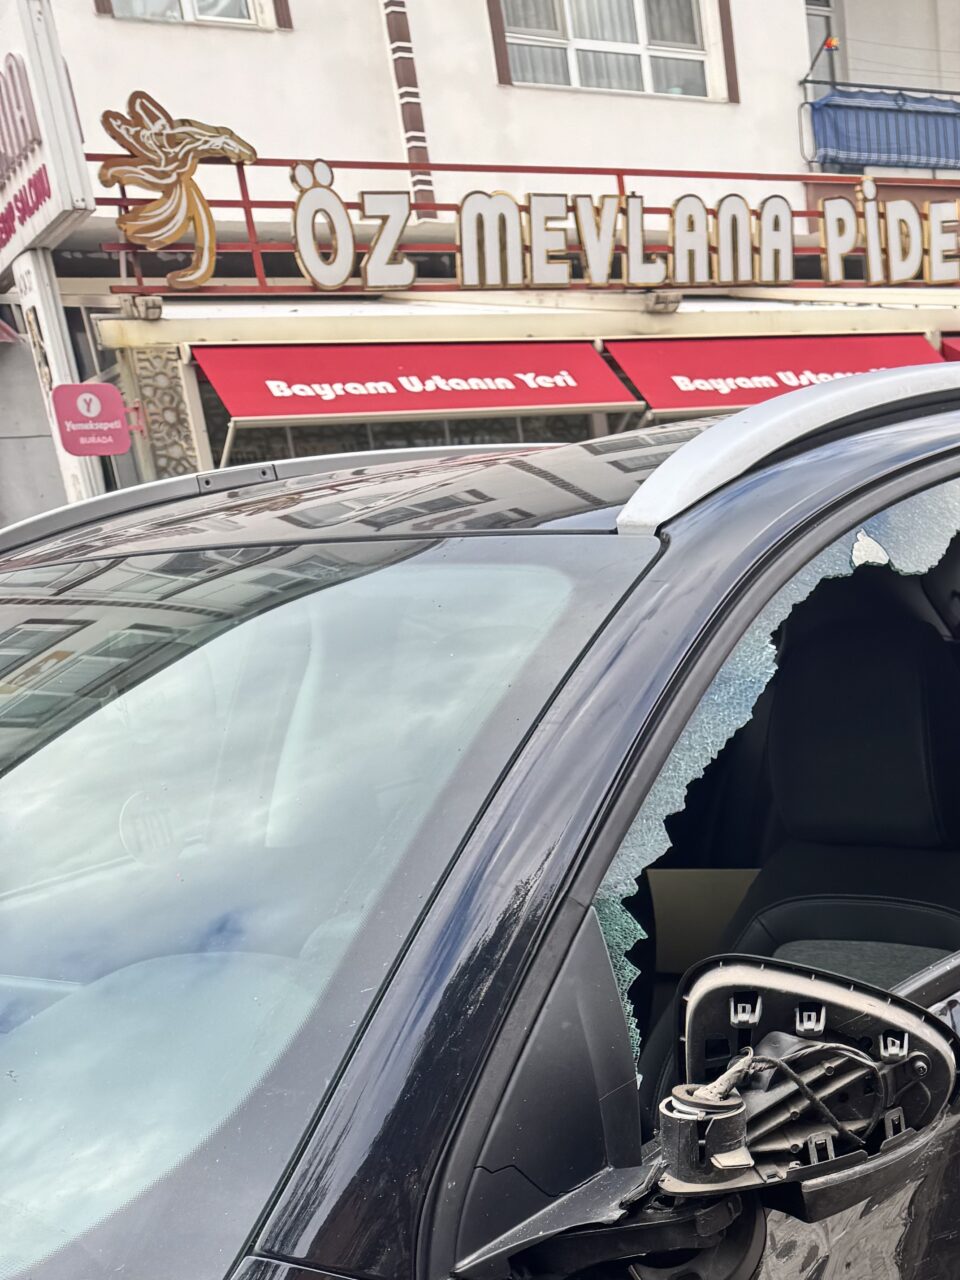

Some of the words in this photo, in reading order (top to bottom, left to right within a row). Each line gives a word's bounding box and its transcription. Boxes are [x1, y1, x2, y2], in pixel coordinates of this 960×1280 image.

[291, 159, 417, 290] ÖZ
[457, 190, 795, 288] MEVLANA
[265, 379, 398, 401] Bayram
[397, 374, 516, 393] Ustanın
[514, 370, 578, 389] Yeri
[671, 375, 779, 395] Bayram
[83, 397, 92, 412] Y
